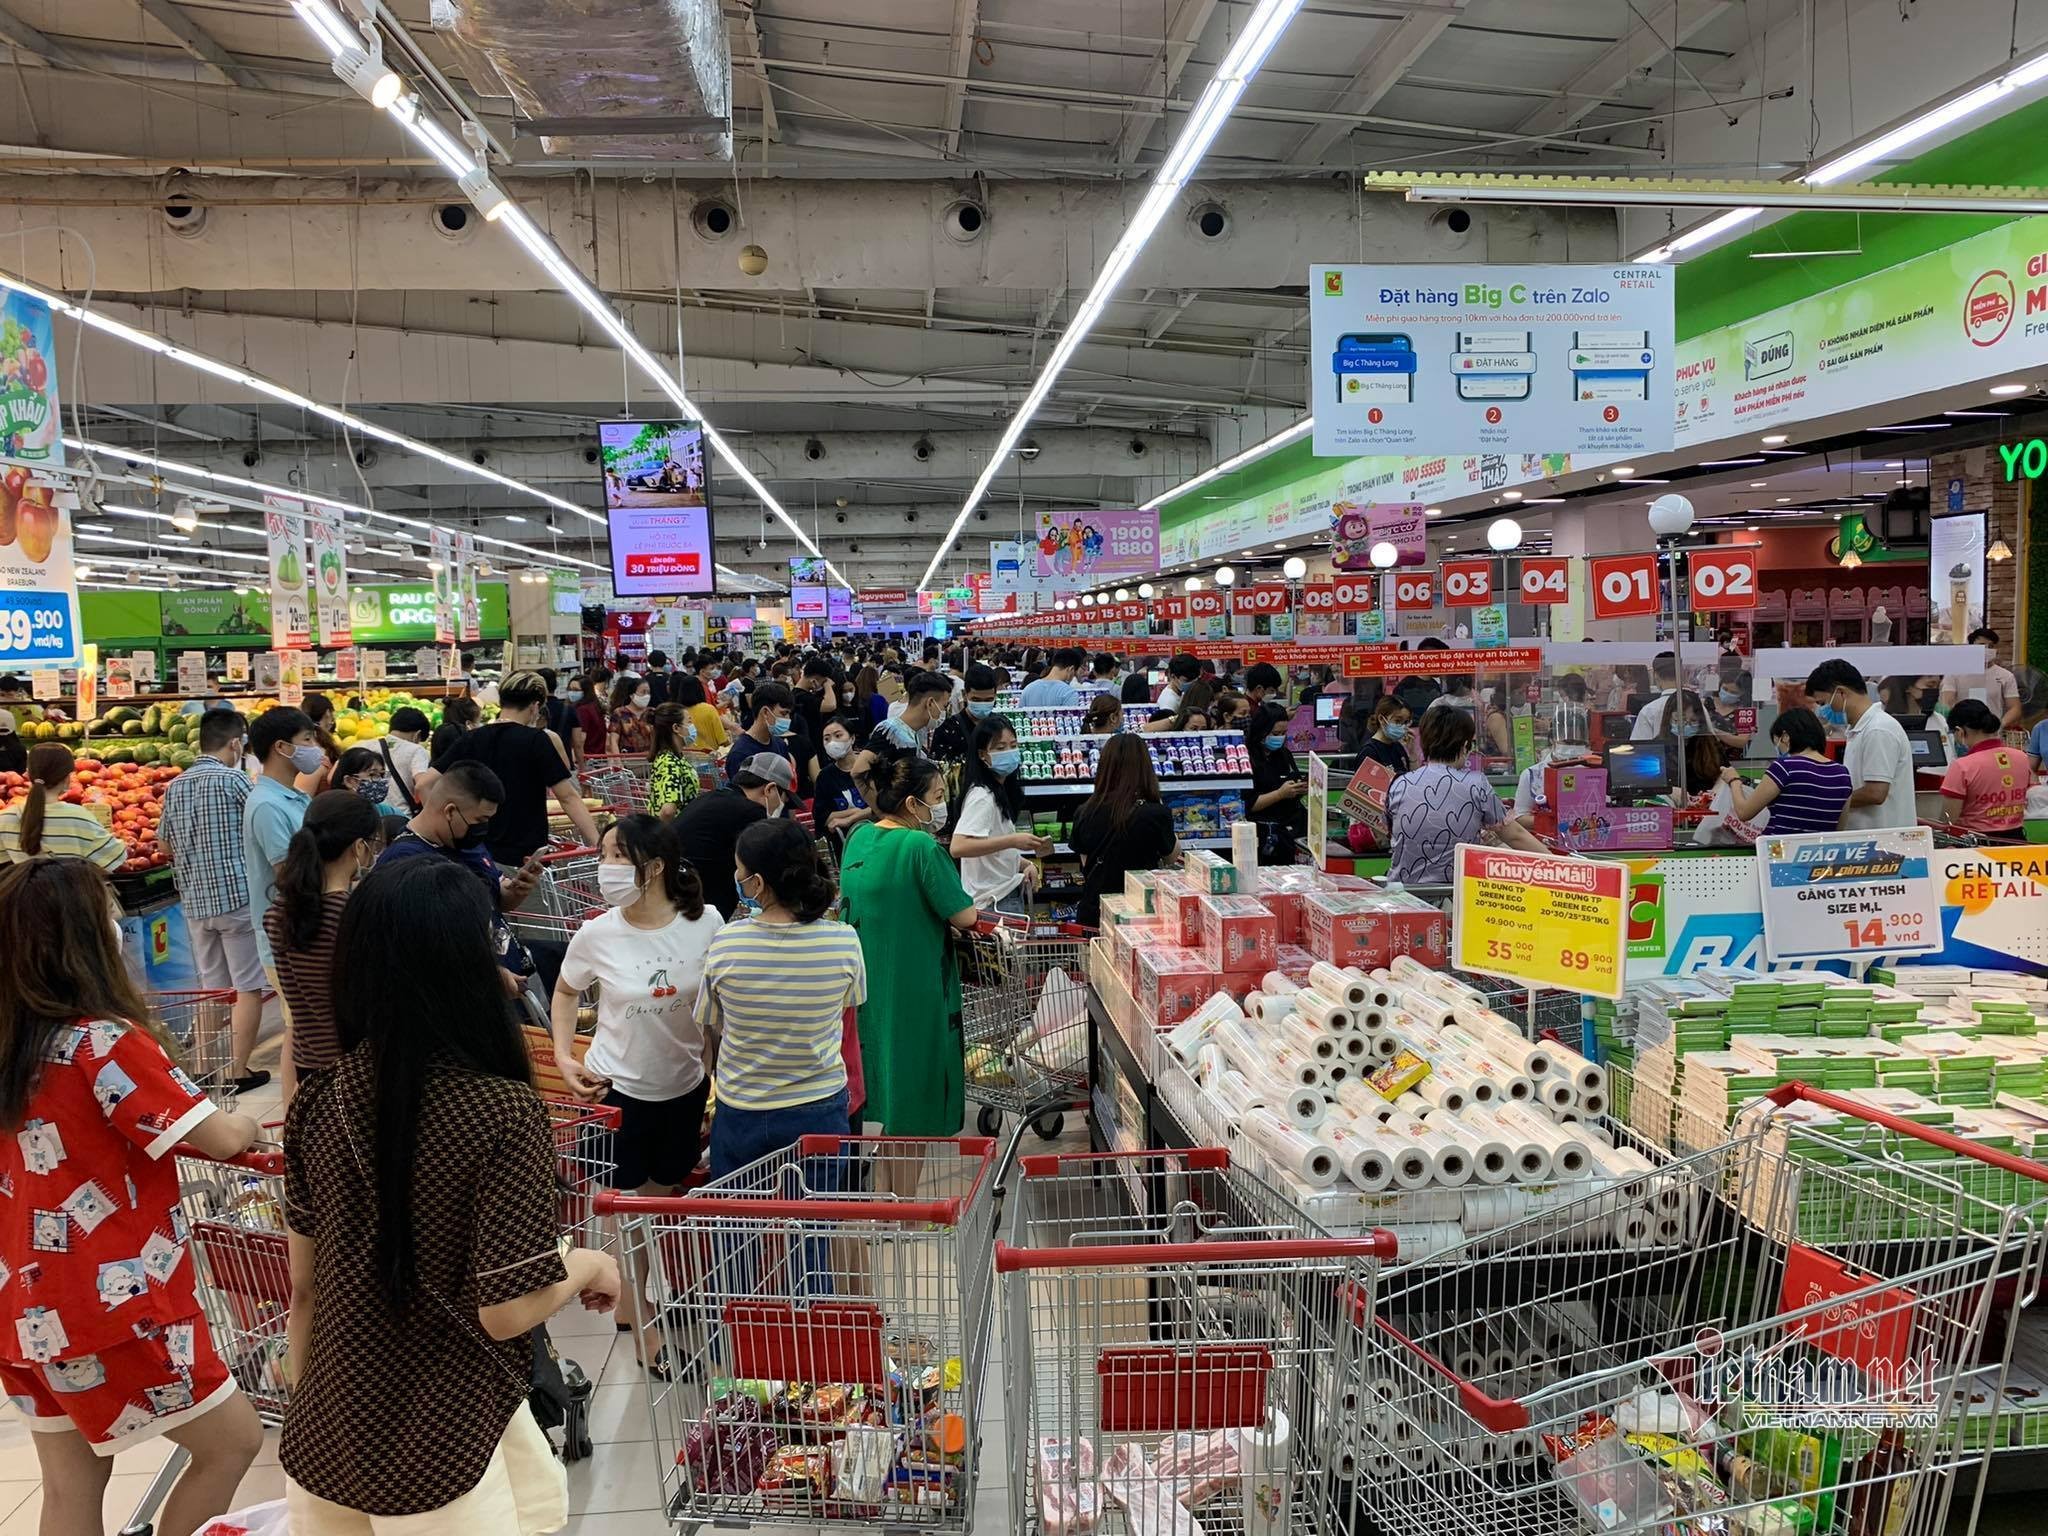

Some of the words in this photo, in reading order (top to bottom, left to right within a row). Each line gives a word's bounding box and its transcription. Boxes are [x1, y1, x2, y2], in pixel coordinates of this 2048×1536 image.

[1613, 270, 1662, 279] CENTRAL
[1620, 280, 1655, 289] RETAIL
[1379, 288, 1410, 307] Đặt
[1416, 288, 1458, 307] hàng
[1464, 284, 1502, 309] Big
[1509, 284, 1527, 304] C
[1532, 289, 1567, 304] trên
[1571, 287, 1610, 303] Zalo
[1365, 313, 1385, 322] Miễn
[1387, 313, 1399, 324] phí
[1400, 315, 1417, 324] giao
[1419, 313, 1439, 324] hàng
[1441, 314, 1462, 324] trong
[1465, 313, 1488, 322] 10km
[1490, 313, 1501, 322] với
[1519, 313, 1534, 322] đơn
[1610, 313, 1622, 322] lên
[1827, 333, 1849, 347] KHÔNG
[1761, 343, 1789, 364] ĐÚNG
[1827, 358, 1837, 368] SAI
[1864, 342, 1883, 357] PHẨM
[1343, 359, 1354, 368] Big
[1360, 359, 1381, 368] Thăng
[1382, 359, 1399, 368] Long
[1476, 357, 1492, 368] ĐẶT
[1494, 356, 1519, 367] HÀNG
[1676, 362, 1700, 382] PHỤC
[1702, 357, 1716, 374] VỤ
[1681, 381, 1701, 396] serve
[1702, 377, 1716, 391] you
[1734, 390, 1752, 402] Khách
[1752, 387, 1767, 399] hàng
[9, 392, 45, 426] KHẨU
[1402, 467, 1419, 485] 1800
[650, 516, 681, 525] THÁNG
[1110, 526, 1153, 540] 1900
[1111, 541, 1153, 555] 1880
[7, 568, 20, 576] NEW
[21, 567, 47, 577] ZEALAND
[630, 564, 645, 573] 30
[646, 563, 670, 575] TRIỆU
[670, 561, 696, 573] ĐỒNG
[1445, 571, 1489, 598] 03
[1521, 569, 1567, 594] 04
[1601, 568, 1651, 603] 01
[1694, 563, 1753, 597] 02
[389, 592, 422, 605] RAU
[1335, 585, 1368, 604] 05
[1397, 581, 1431, 602] 06
[1191, 596, 1216, 610] 09
[1255, 591, 1283, 607] 07
[1305, 591, 1333, 607] 08
[1101, 608, 1114, 618] 15
[1122, 605, 1138, 617] 13
[1168, 602, 1182, 614] 11
[1070, 612, 1081, 621] 19
[1085, 611, 1097, 620] 17
[1399, 653, 1418, 661] chắn
[1419, 652, 1439, 662] được
[1454, 651, 1465, 661] đặt
[1474, 651, 1485, 660] sự
[1384, 661, 1401, 670] sức
[1625, 811, 1660, 822] 1900
[1625, 822, 1660, 833] 1880
[1797, 846, 1839, 863] BẢO
[1845, 841, 1871, 861] VỆ
[1870, 863, 1900, 875] BẠN
[1479, 890, 1504, 901] GREEN
[1505, 894, 1523, 903] ECO
[1515, 886, 1526, 894] TP
[1797, 887, 1836, 902] GĂNG
[1838, 886, 1867, 899] TAY
[1869, 885, 1906, 897] THSH
[1961, 881, 2042, 899] RETAIL
[1551, 900, 1579, 911] GREEN
[1581, 904, 1598, 913] ECO
[1590, 896, 1602, 904] TP
[1827, 903, 1857, 915] SIZE
[1859, 902, 1882, 914] M,L
[1485, 916, 1515, 928] 49.900
[1843, 918, 1887, 948] 14
[1487, 939, 1512, 960] 35
[1560, 949, 1589, 970] 89
